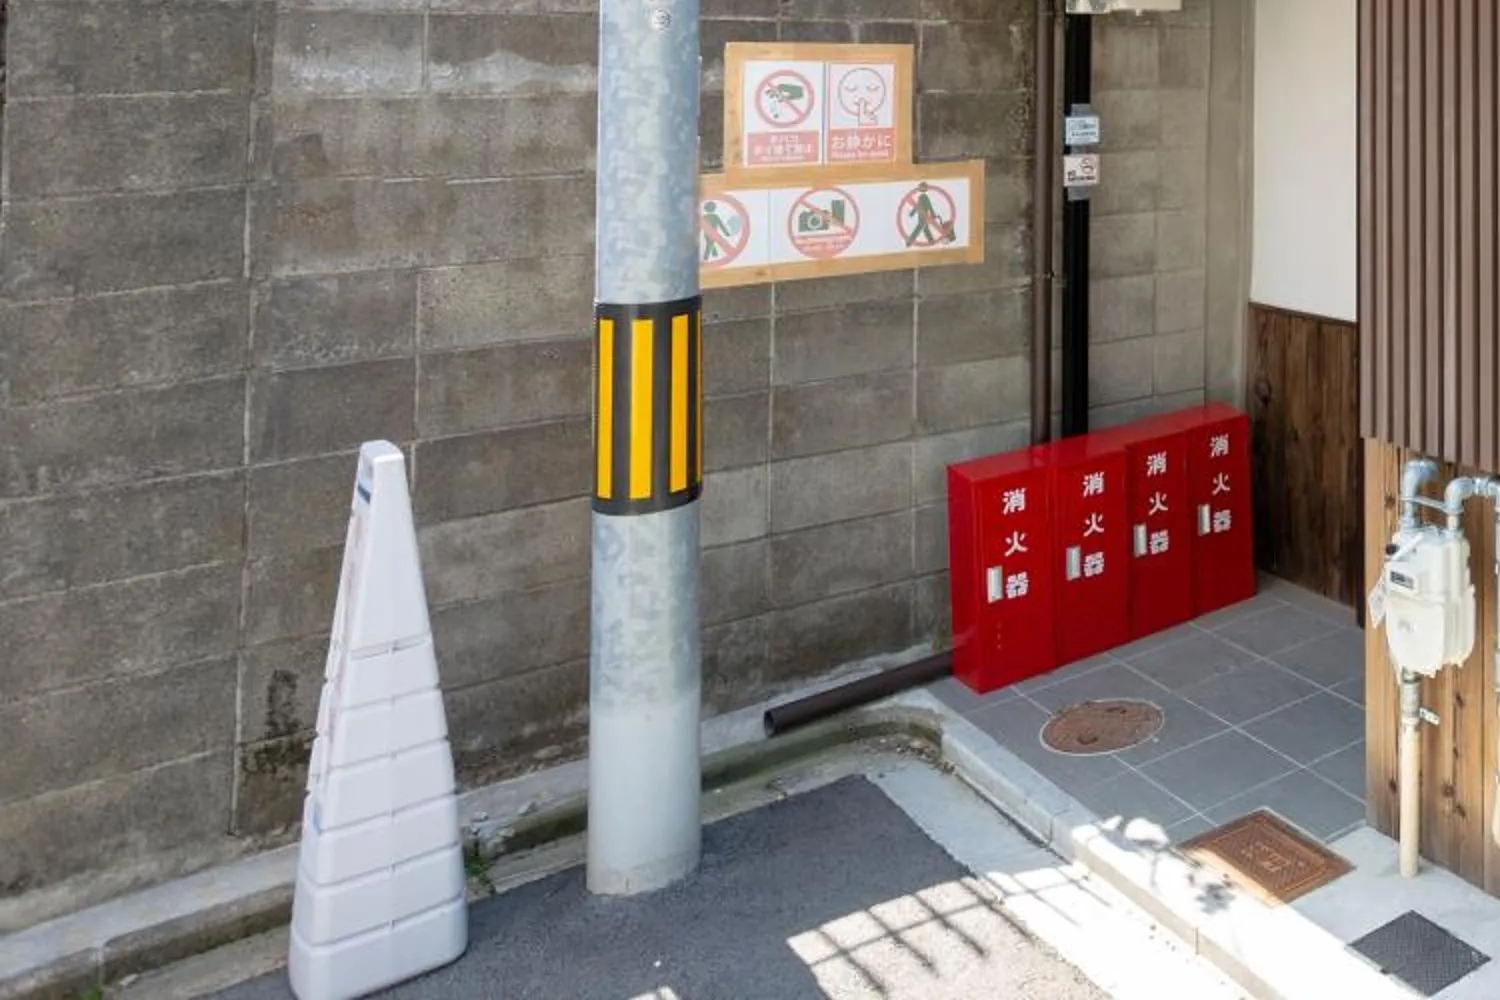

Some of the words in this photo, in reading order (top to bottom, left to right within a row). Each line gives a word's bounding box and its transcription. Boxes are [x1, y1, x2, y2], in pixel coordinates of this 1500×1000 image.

[1082, 471, 1105, 577] 消火器
[1146, 451, 1169, 554] 消火器
[1209, 433, 1232, 533] 消火器
[1002, 487, 1029, 599] 消火器
